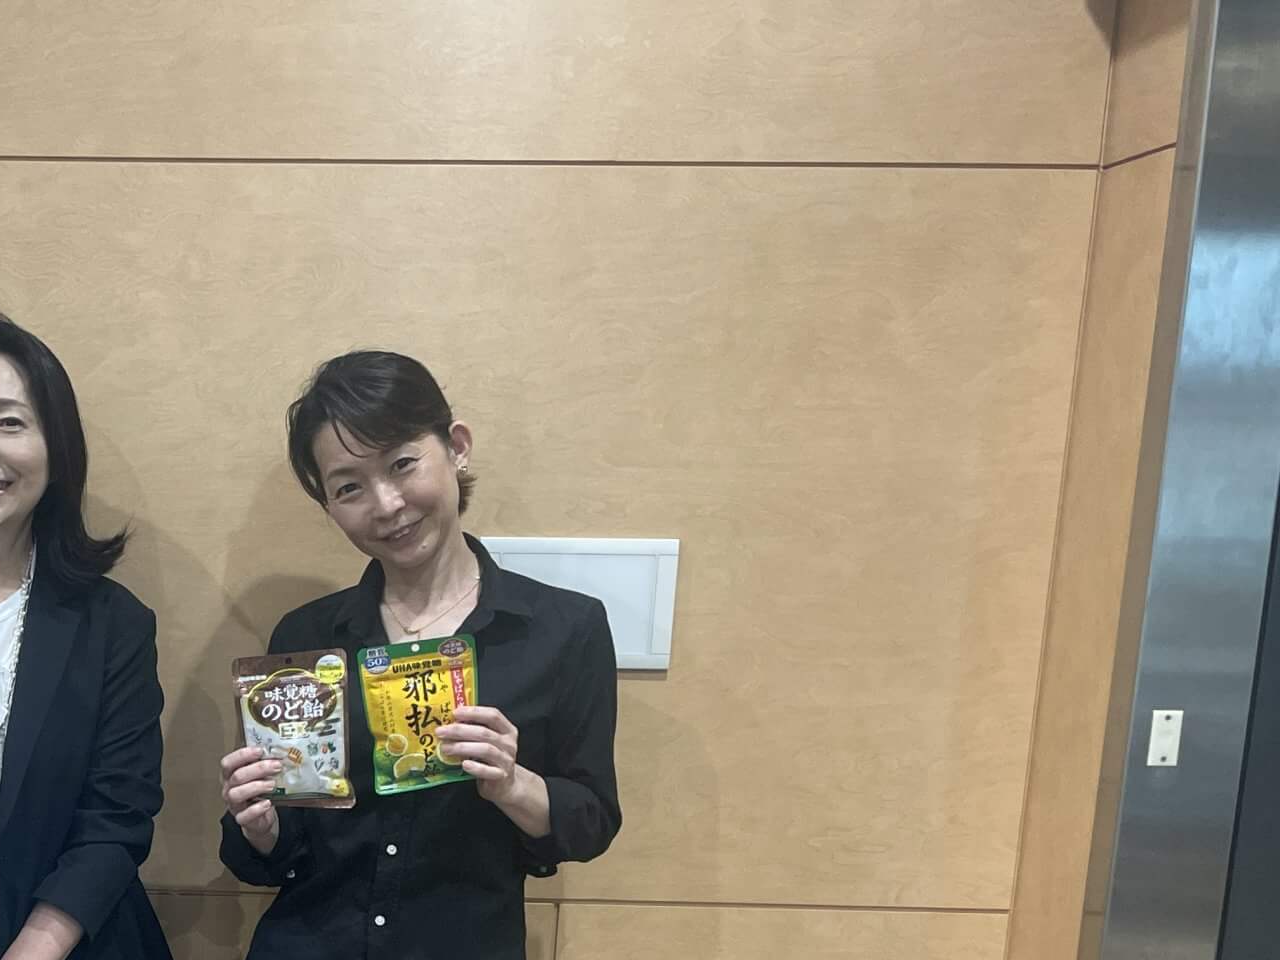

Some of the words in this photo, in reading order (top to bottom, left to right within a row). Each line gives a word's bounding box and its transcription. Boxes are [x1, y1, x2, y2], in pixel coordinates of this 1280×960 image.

[263, 682, 318, 702] 味覚糖
[261, 698, 325, 721] のど飴
